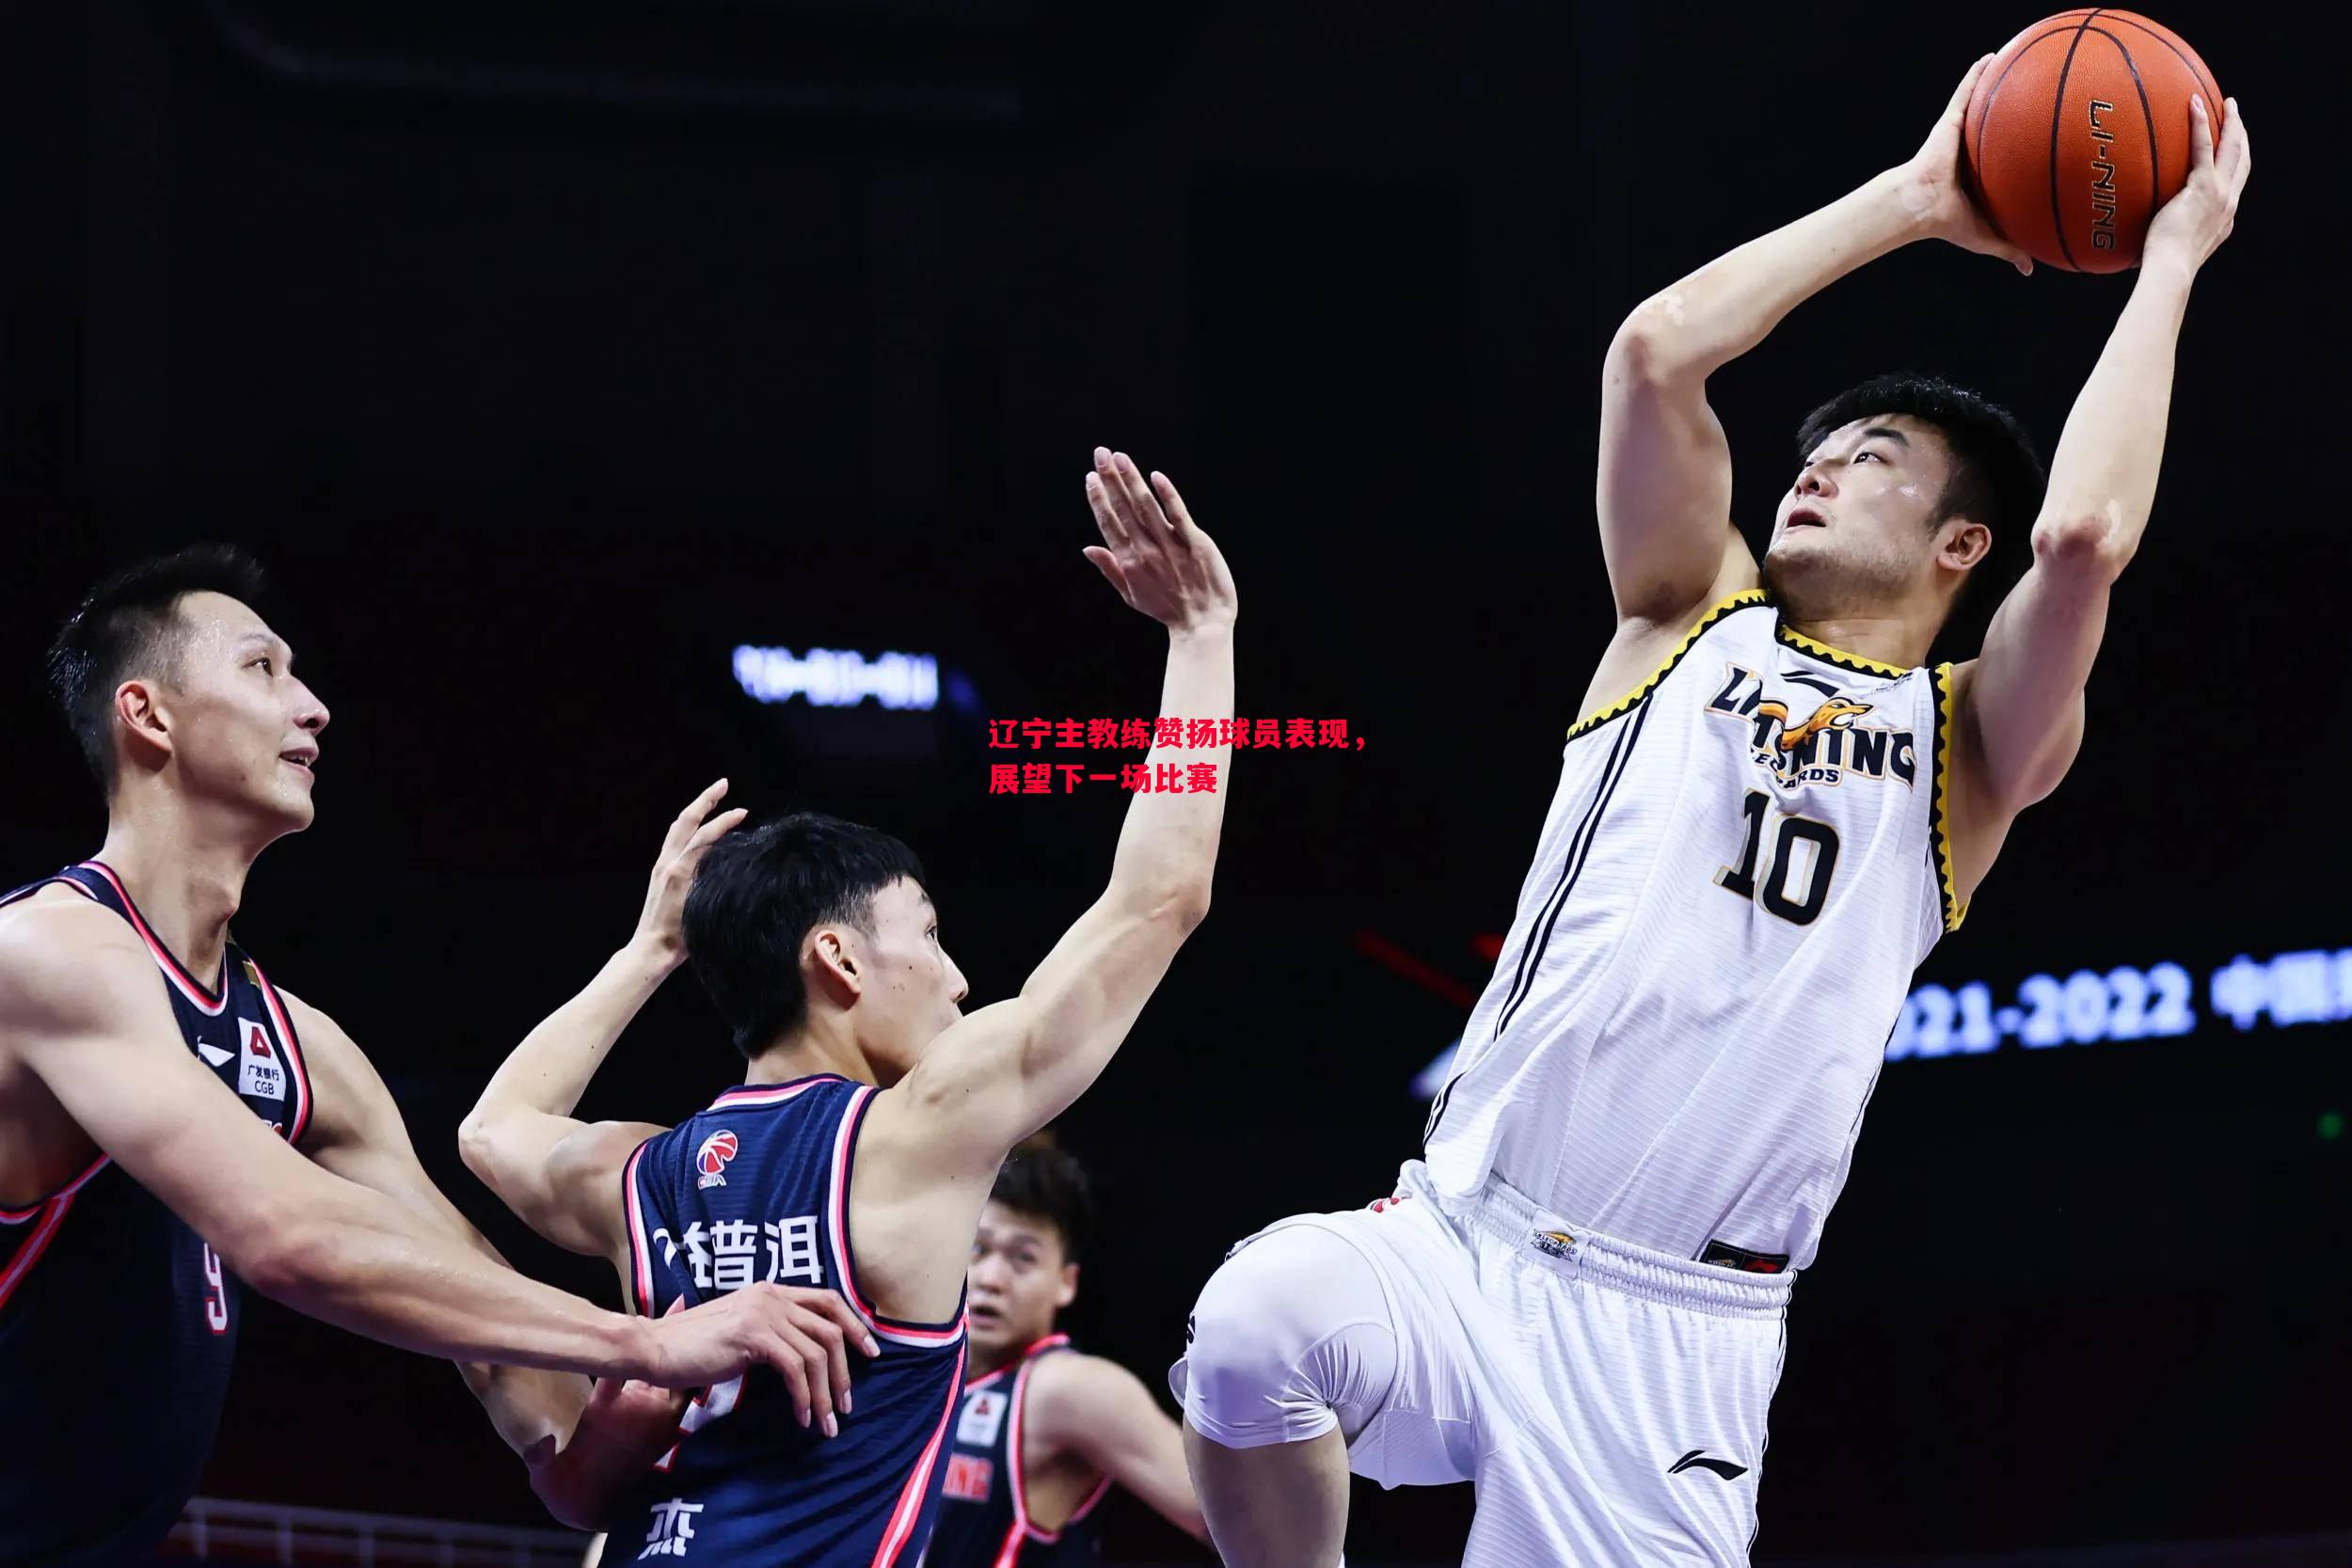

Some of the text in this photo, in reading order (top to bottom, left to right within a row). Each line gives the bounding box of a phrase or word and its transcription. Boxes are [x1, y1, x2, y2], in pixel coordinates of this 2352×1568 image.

[2089, 100, 2116, 251] LI-NING
[1713, 787, 1841, 927] 10
[254, 1081, 276, 1096] CGB
[637, 1497, 705, 1560] 杰
